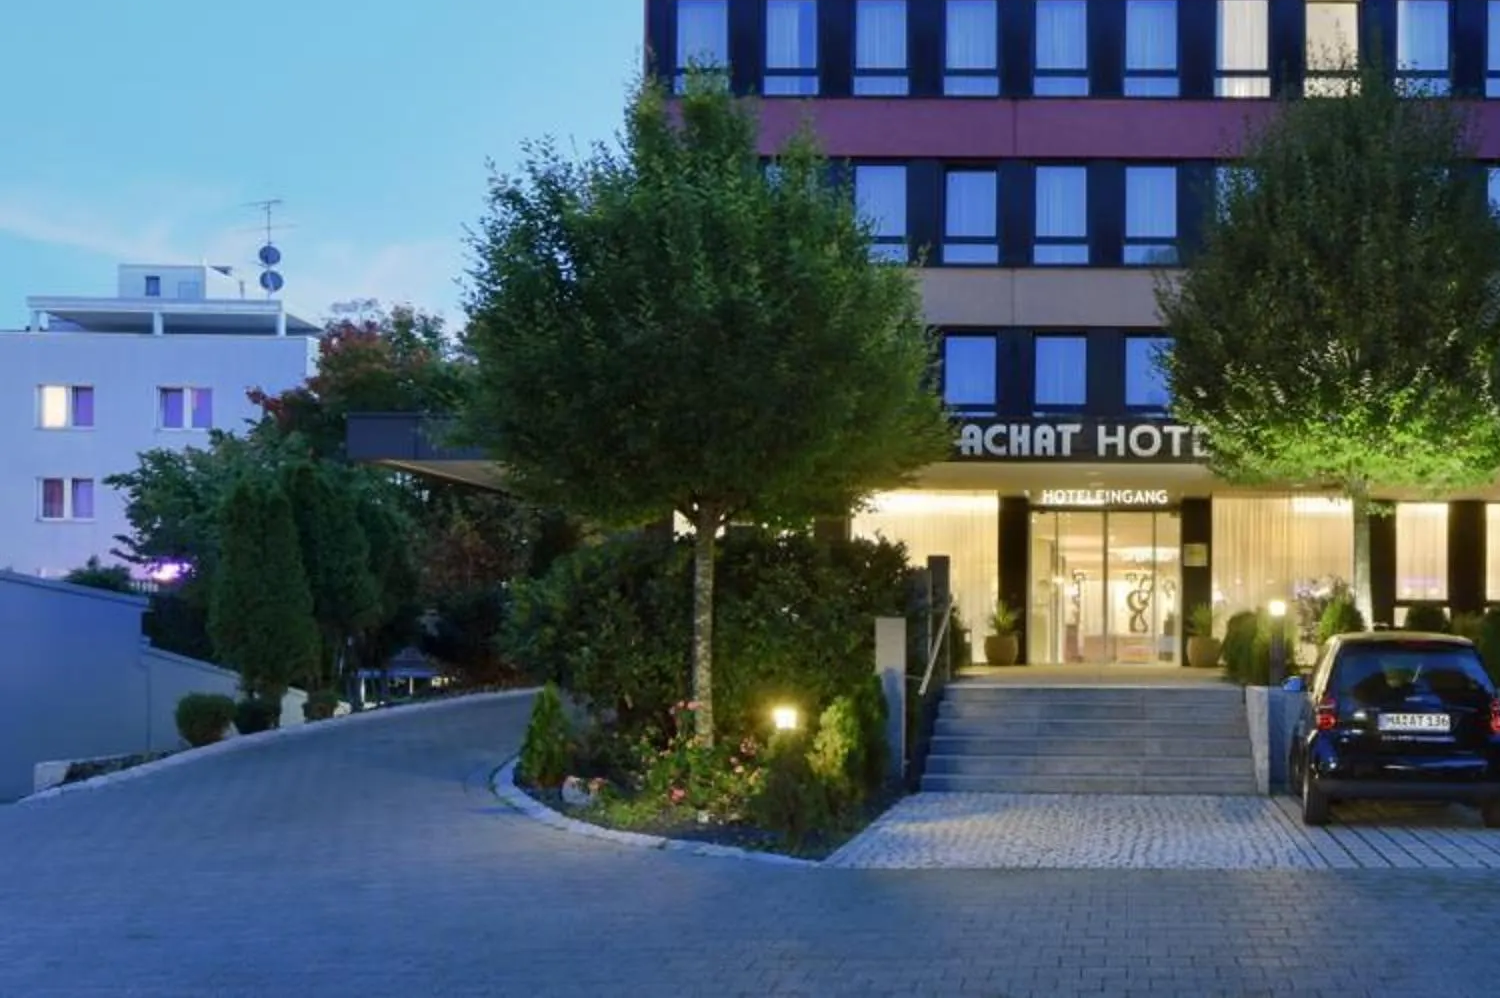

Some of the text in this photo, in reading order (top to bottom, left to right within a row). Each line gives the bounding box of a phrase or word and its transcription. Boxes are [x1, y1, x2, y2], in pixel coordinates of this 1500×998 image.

[957, 424, 1216, 457] ACHAT HOTE
[1042, 489, 1168, 505] HOTELEINGANG
